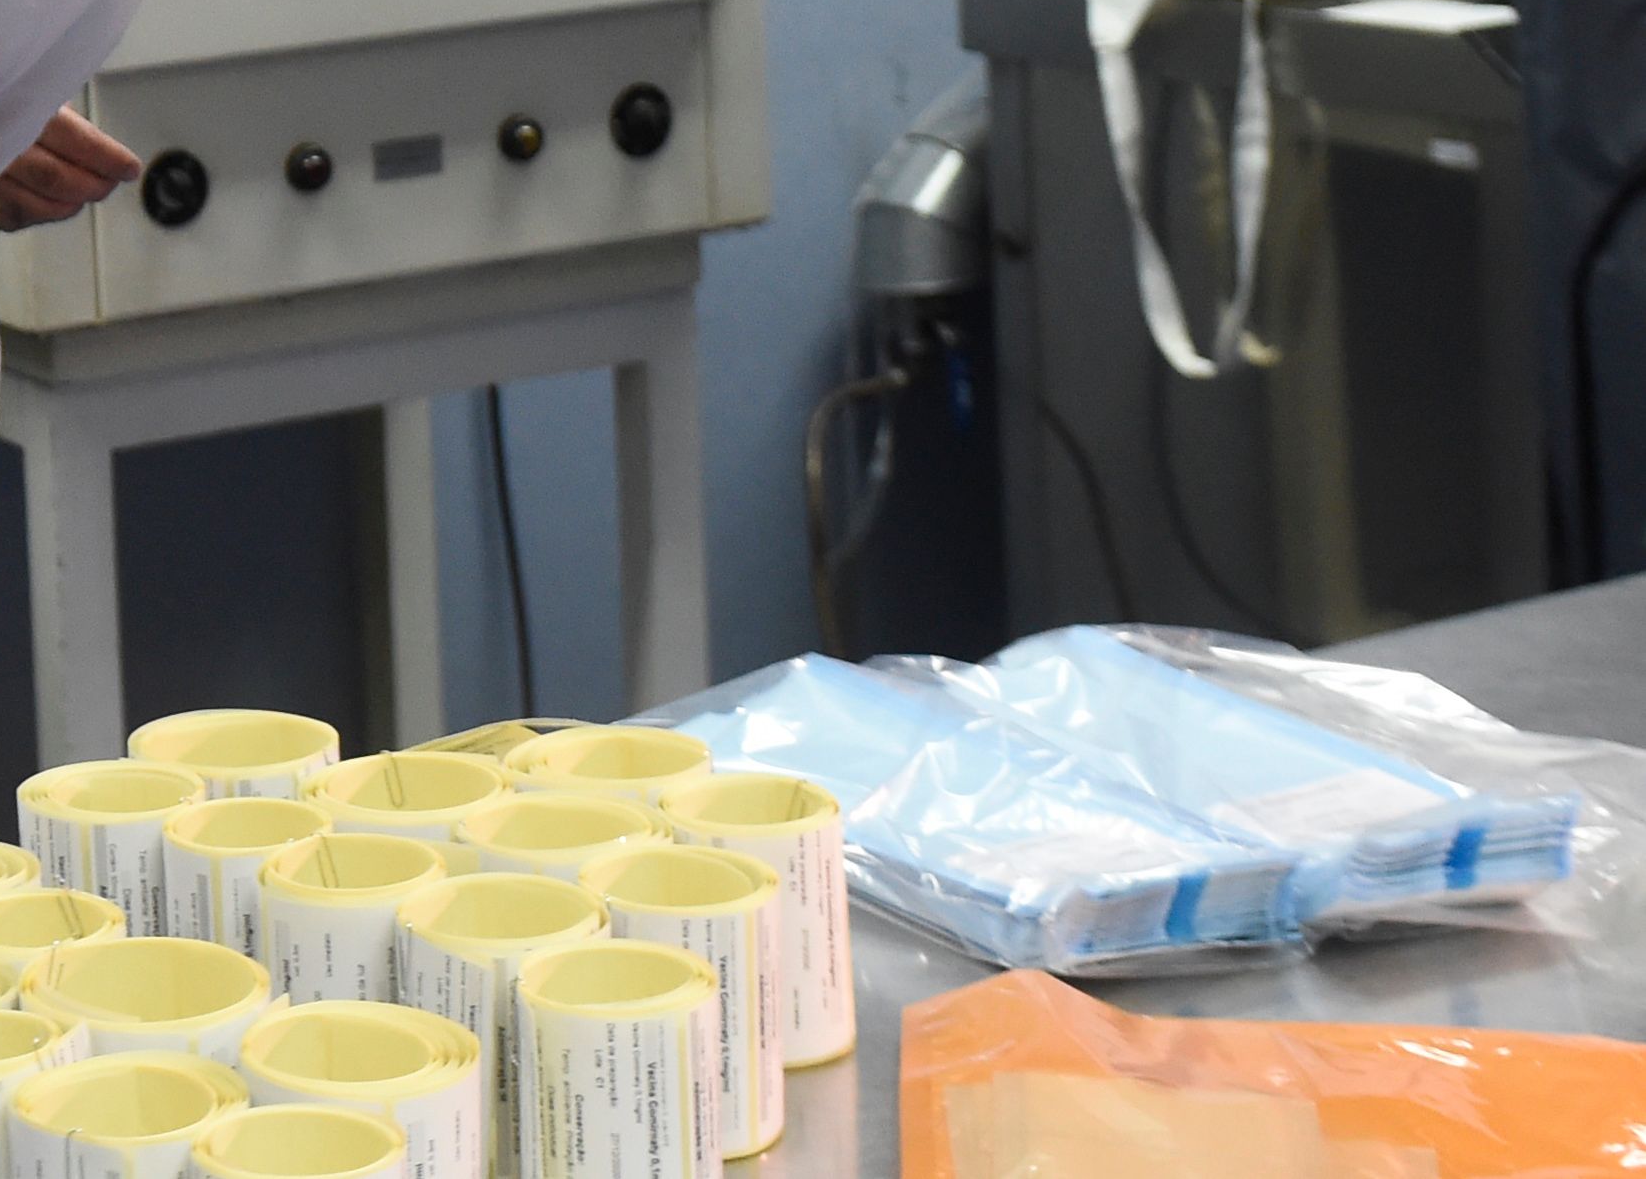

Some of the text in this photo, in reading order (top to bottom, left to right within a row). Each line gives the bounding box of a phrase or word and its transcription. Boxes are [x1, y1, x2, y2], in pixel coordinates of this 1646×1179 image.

[607, 1023, 616, 1042] Data
[608, 1045, 616, 1056] de
[647, 1062, 658, 1098] Vacina
[648, 1100, 660, 1155] Comirnaty
